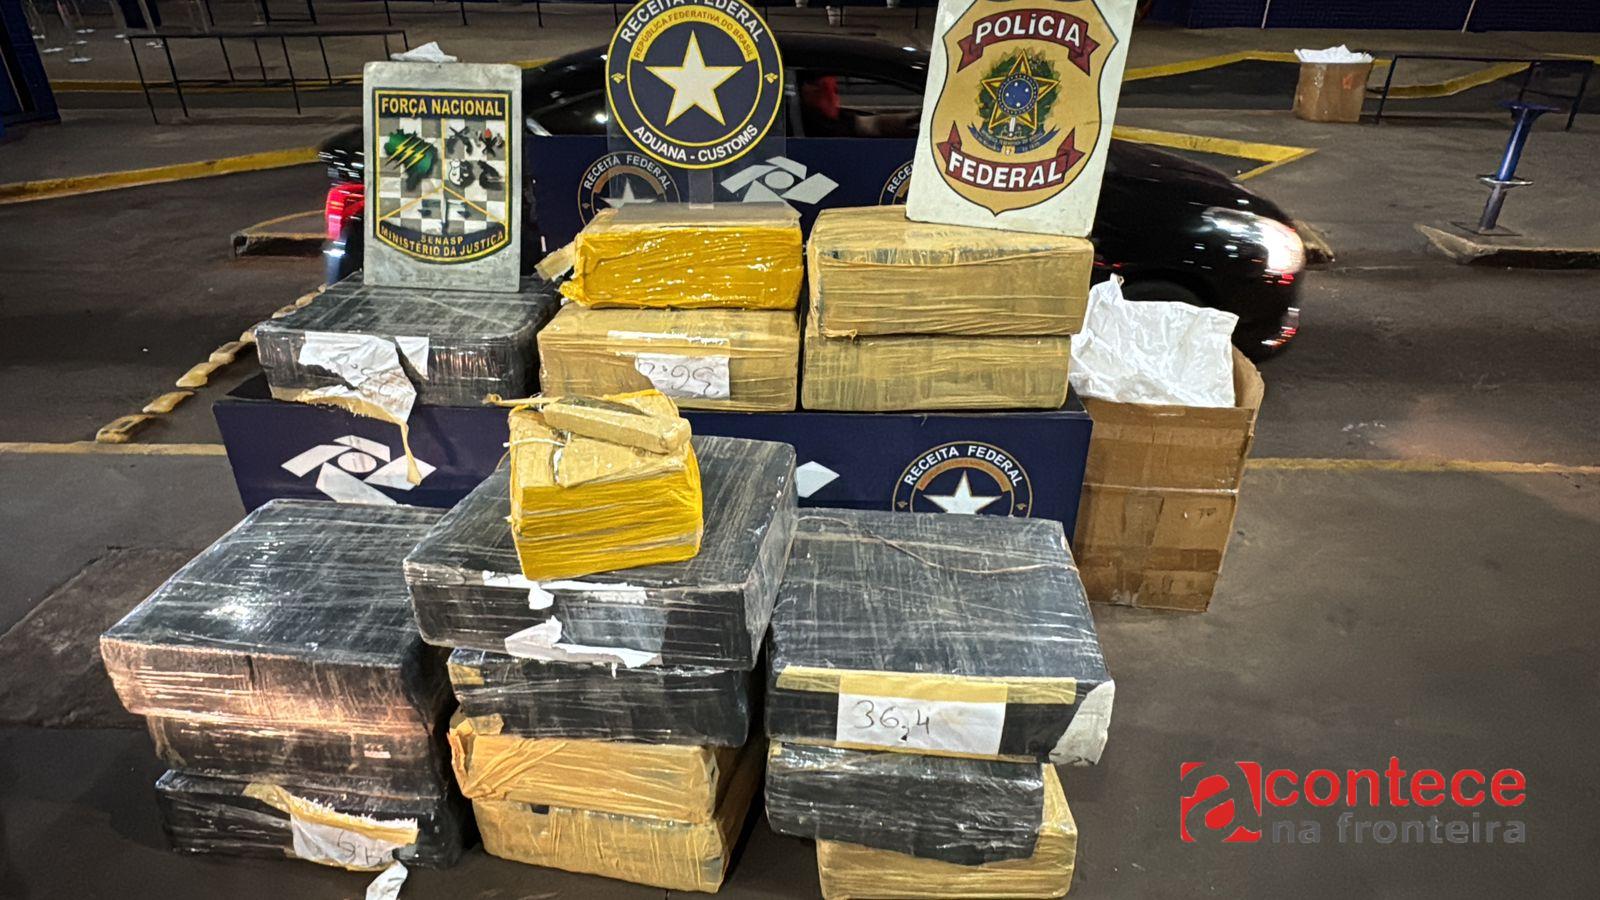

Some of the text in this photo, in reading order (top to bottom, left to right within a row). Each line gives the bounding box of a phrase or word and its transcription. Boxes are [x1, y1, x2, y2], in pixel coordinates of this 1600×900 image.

[668, 10, 720, 23] FEDERATIVA
[720, 20, 734, 31] DO
[732, 27, 754, 58] BRASIL
[694, 0, 763, 42] DERAL
[381, 97, 503, 117] FORÇA NACIONAL
[633, 126, 687, 162] ADUANA
[697, 125, 759, 162] CUSTOMS
[583, 154, 672, 190] RECEITA FEDERAL
[887, 163, 914, 193] RECE
[949, 151, 1063, 189] FEDERAL
[421, 235, 464, 245] SENASP
[443, 246, 457, 256] DA
[460, 230, 503, 256] JUSTIÇA
[904, 445, 1023, 487] RECEITA FEDERAL
